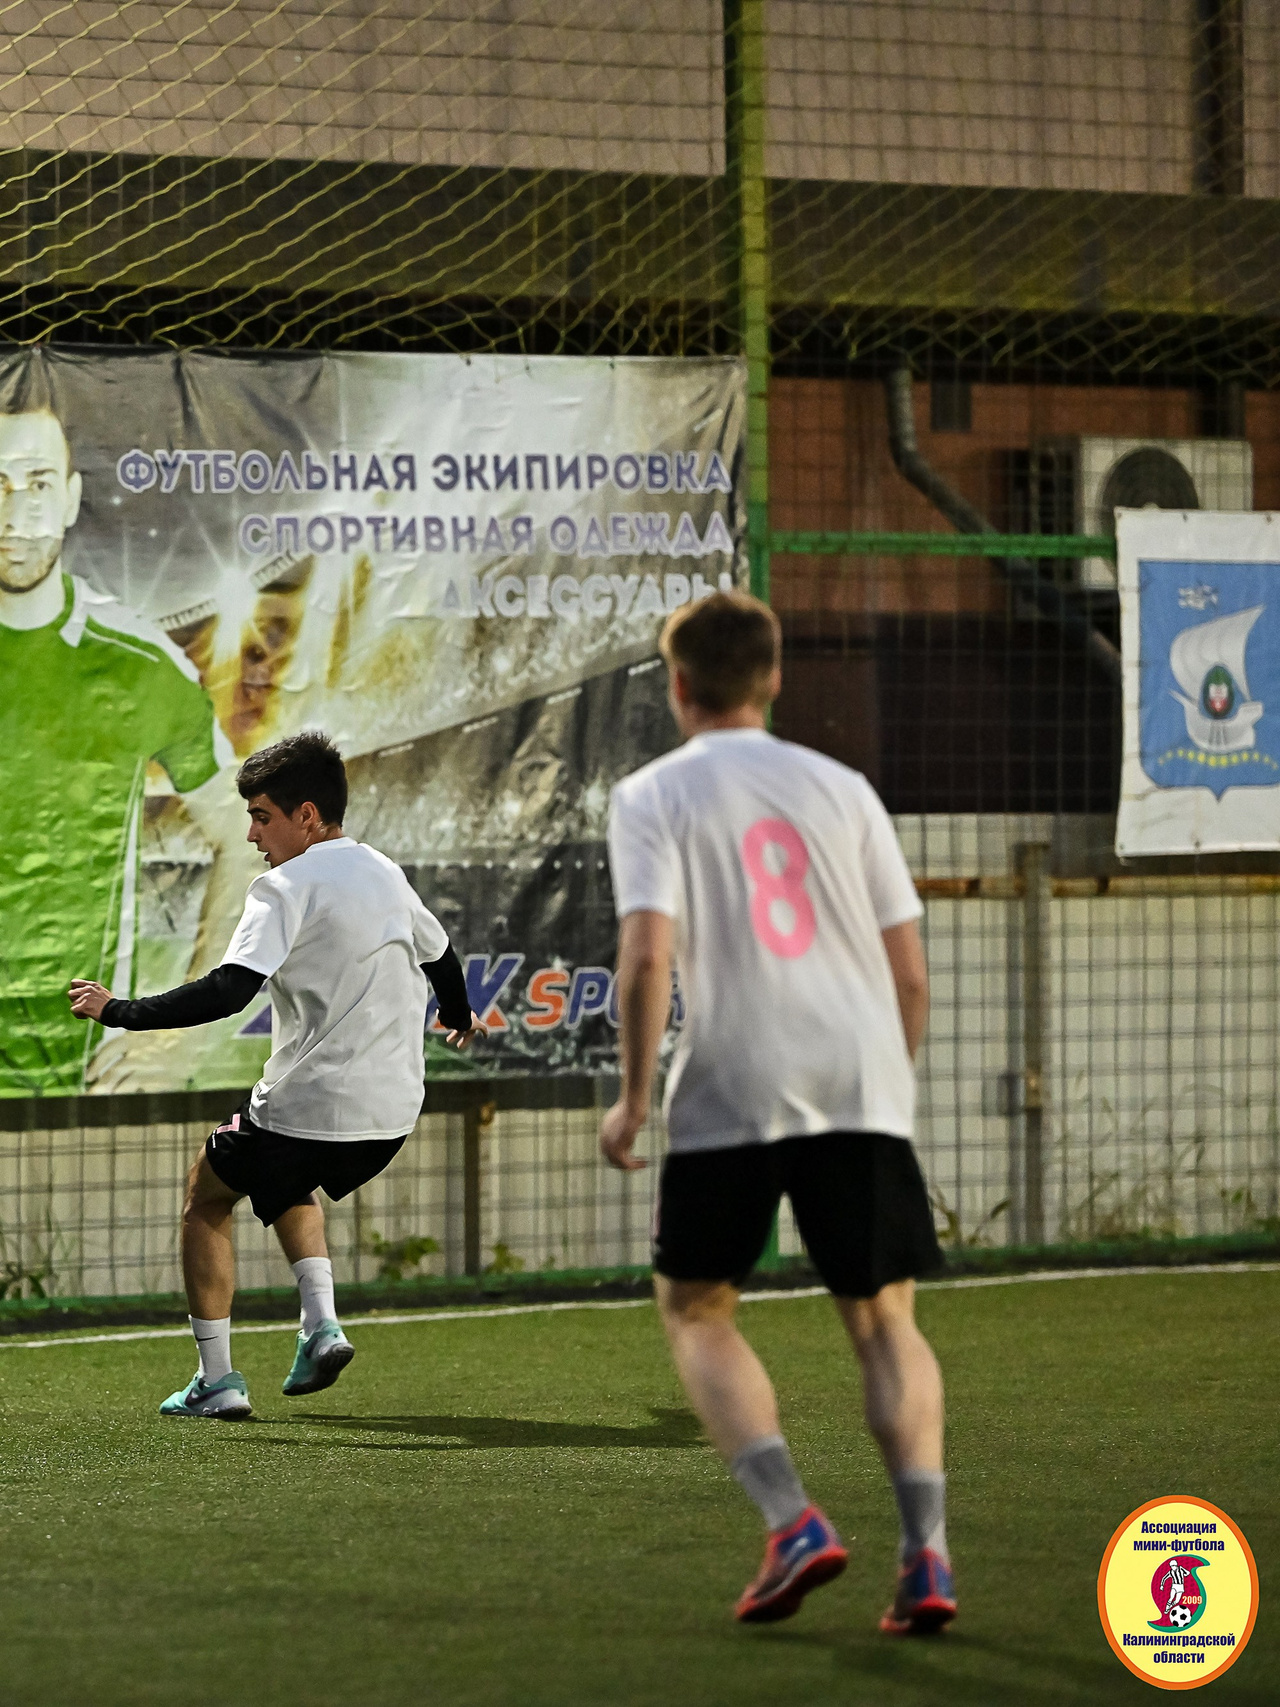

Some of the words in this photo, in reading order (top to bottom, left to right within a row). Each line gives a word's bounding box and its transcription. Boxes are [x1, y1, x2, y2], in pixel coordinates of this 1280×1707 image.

[117, 449, 418, 494] ФУТБОЛЬНАЯ
[431, 450, 732, 494] ЭКИПИРОВКА
[240, 514, 534, 556] СПОРТИВНАЯ
[549, 511, 734, 559] ОДЕЖДА
[741, 816, 817, 962] 8
